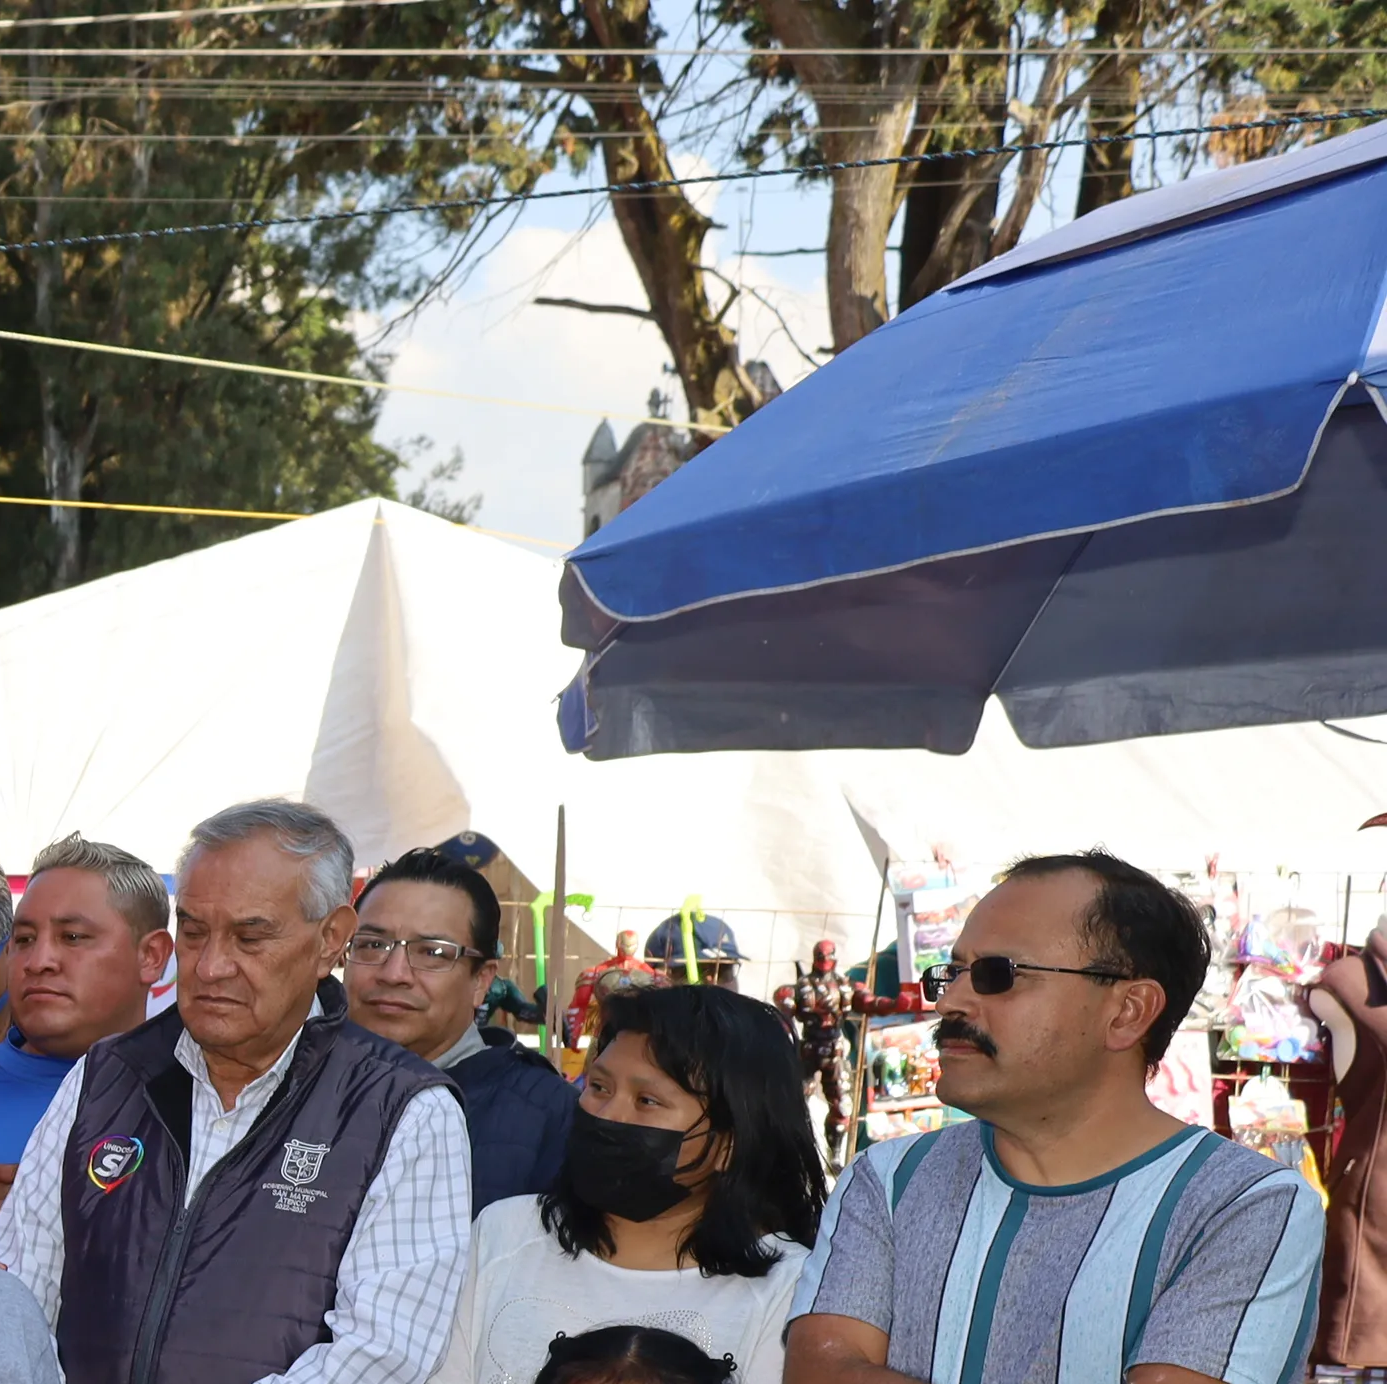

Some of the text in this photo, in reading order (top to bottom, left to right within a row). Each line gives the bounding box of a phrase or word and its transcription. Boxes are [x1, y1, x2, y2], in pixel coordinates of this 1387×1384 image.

[272, 1189, 316, 1202] SAN MATEO
[277, 1197, 307, 1208] ATENCO
